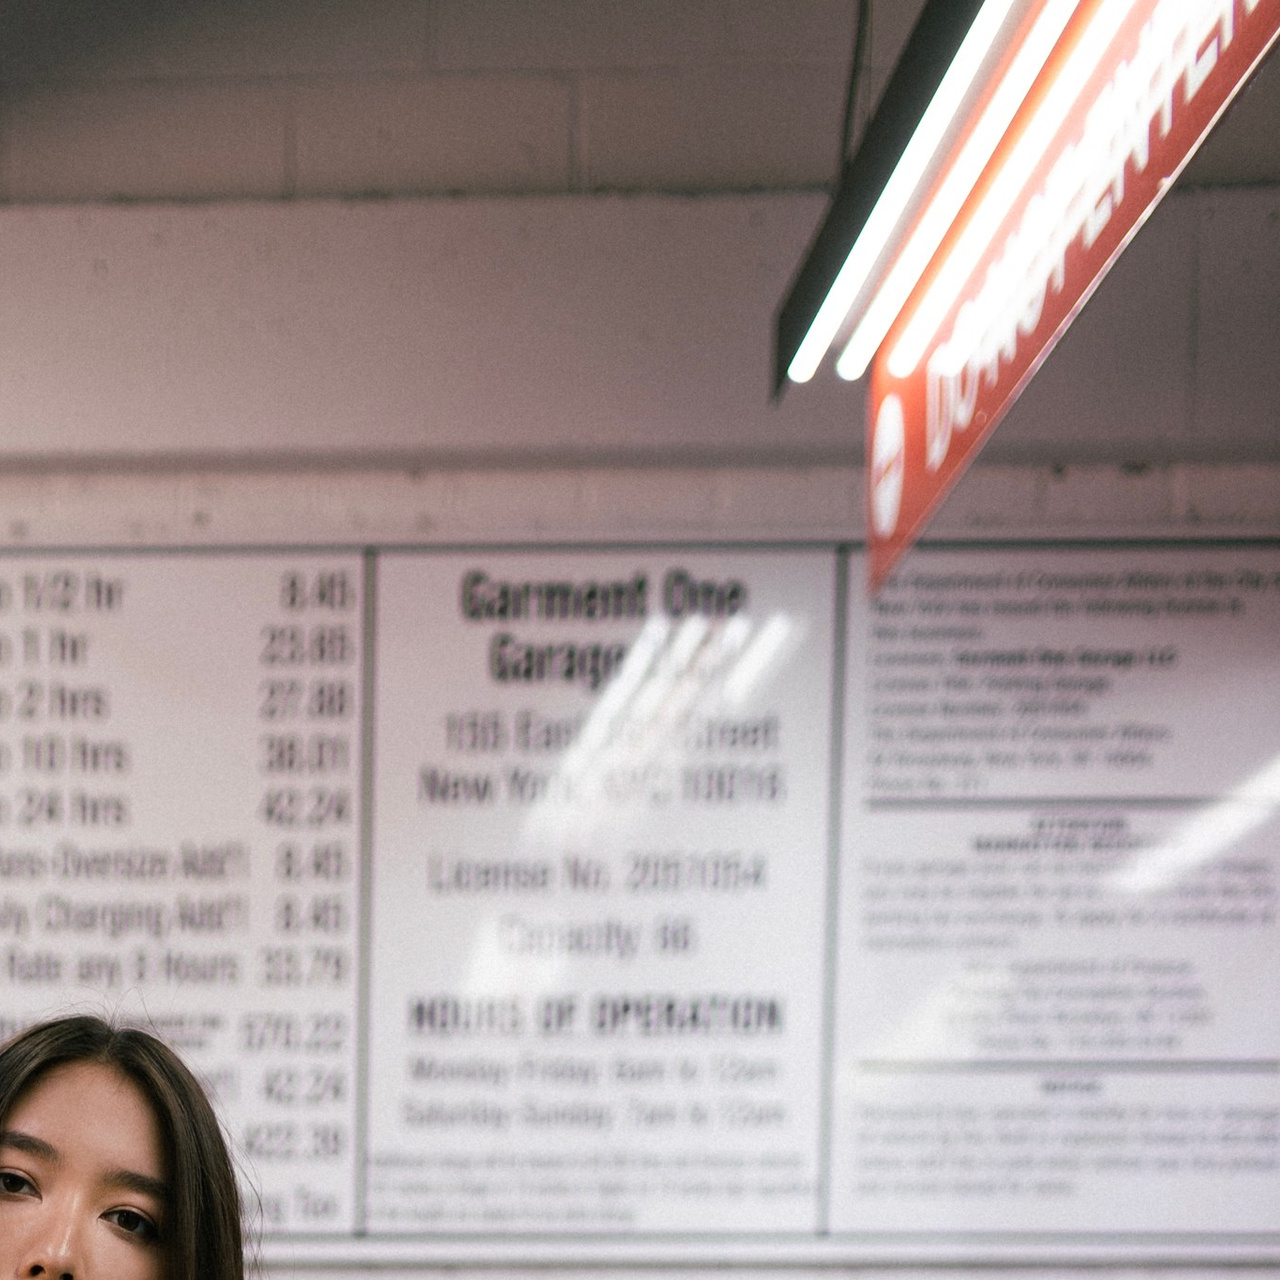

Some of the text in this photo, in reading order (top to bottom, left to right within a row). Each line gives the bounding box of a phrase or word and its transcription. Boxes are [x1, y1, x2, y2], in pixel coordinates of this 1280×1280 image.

[926, 295, 978, 473] DO
[987, 140, 1076, 388] NOT
[23, 573, 76, 614] 1/2
[88, 573, 122, 614] hr
[462, 570, 747, 624] Garment One
[52, 629, 86, 668] hr
[19, 683, 41, 723] 2
[52, 683, 108, 723] hrs
[518, 713, 586, 755] Eas
[23, 736, 62, 777] 10
[73, 736, 129, 777] hrs
[421, 766, 497, 807] New
[19, 791, 61, 830] 24
[73, 791, 129, 830] hrs
[259, 788, 349, 828] 42.24
[430, 854, 554, 898] License
[38, 898, 169, 945] Charging
[2, 949, 68, 987] Rate
[71, 956, 123, 996] any
[158, 949, 241, 987] Hours
[410, 996, 784, 1035] HOURS OF OPERATION
